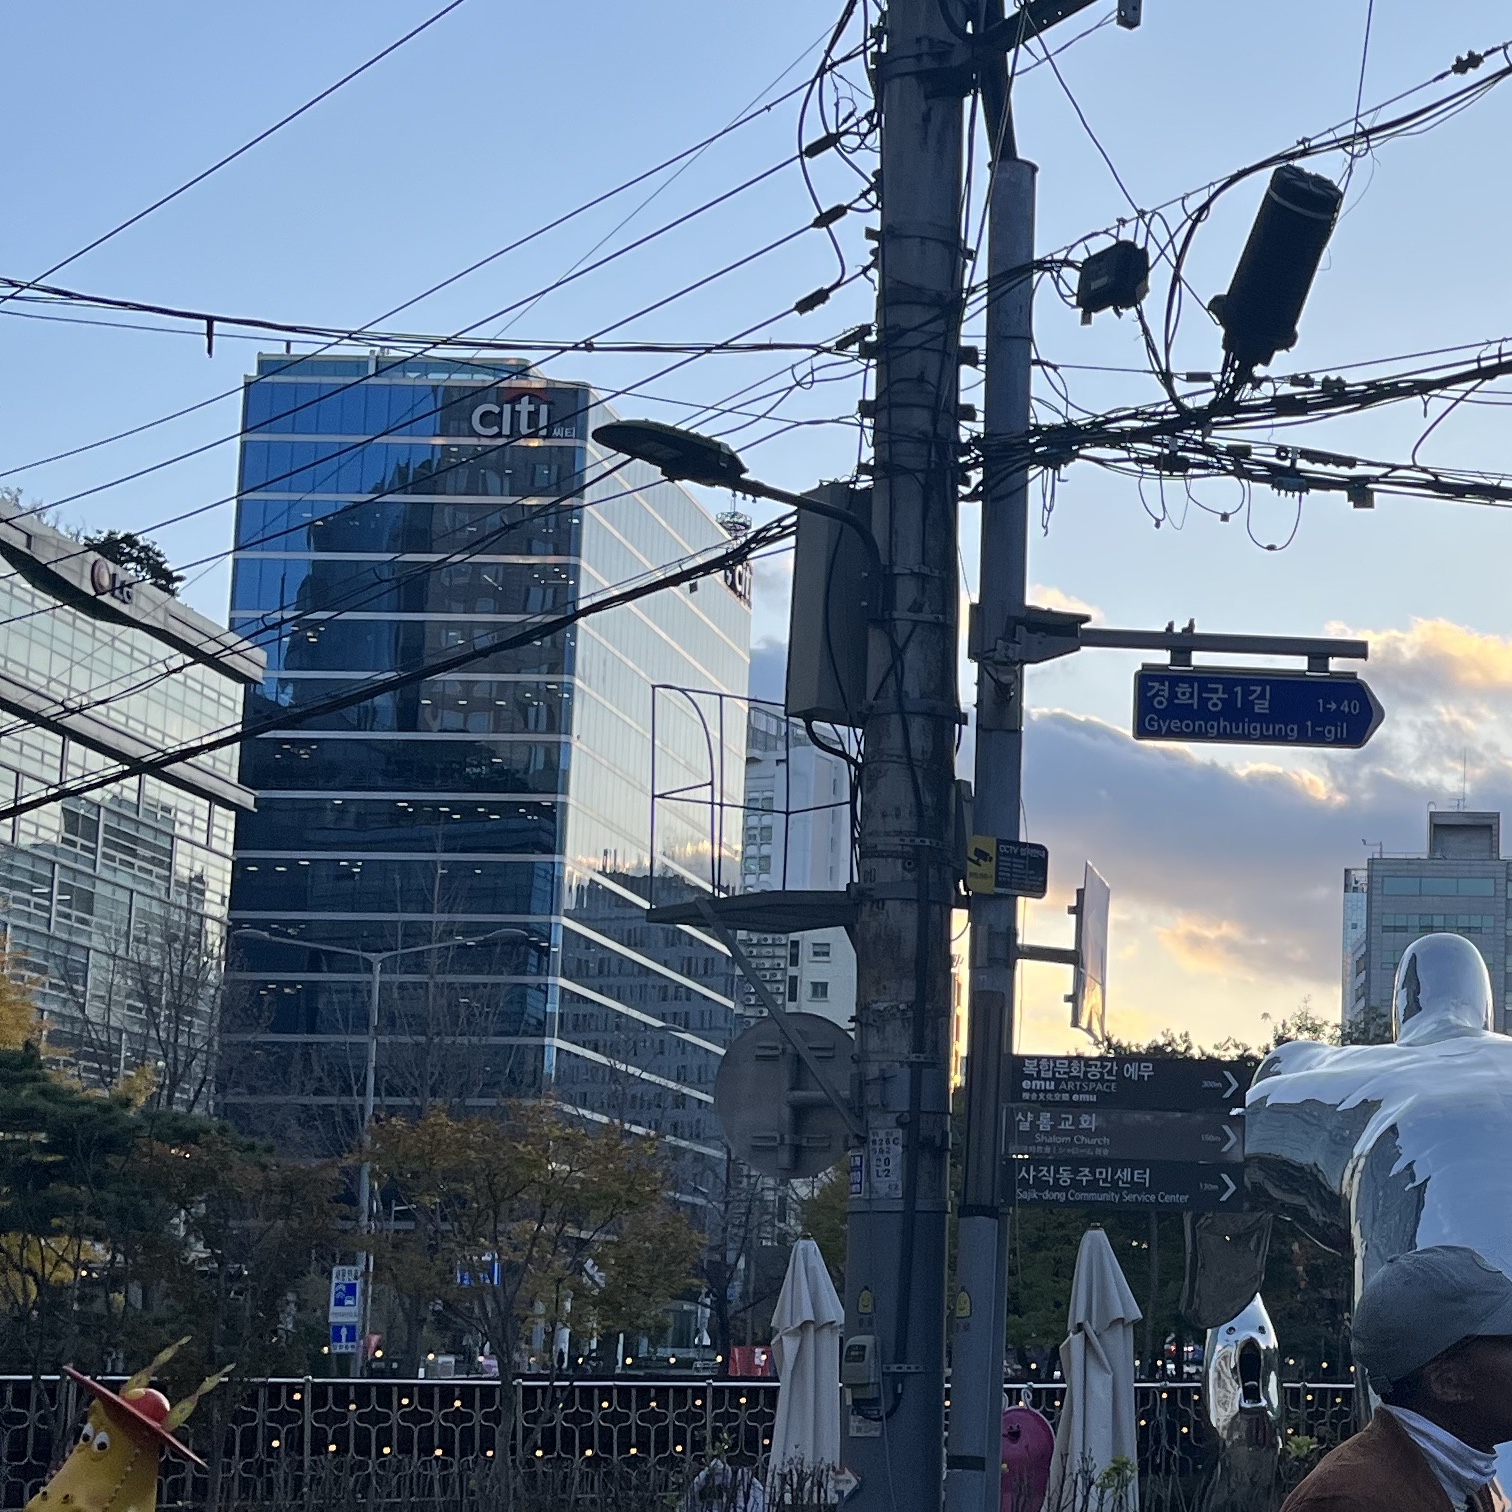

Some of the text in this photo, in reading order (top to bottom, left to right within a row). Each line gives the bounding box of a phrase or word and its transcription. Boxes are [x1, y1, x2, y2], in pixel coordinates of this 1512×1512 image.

[471, 395, 548, 436] citi
[1146, 680, 1271, 713] 경희궁1길
[1144, 714, 1348, 742] Gyeonghuigung 1-gil
[999, 844, 1019, 854] CCTV
[1022, 1058, 1155, 1082] 복합문화공간 에무
[1022, 1080, 1055, 1091] emu
[1058, 1081, 1118, 1093] ARTSPACE
[1034, 1133, 1071, 1145] Shalom
[1074, 1134, 1110, 1146] Church
[1017, 1166, 1150, 1187] 사직동주민센터
[1016, 1188, 1190, 1204] Sajik-dong Community Service Center
